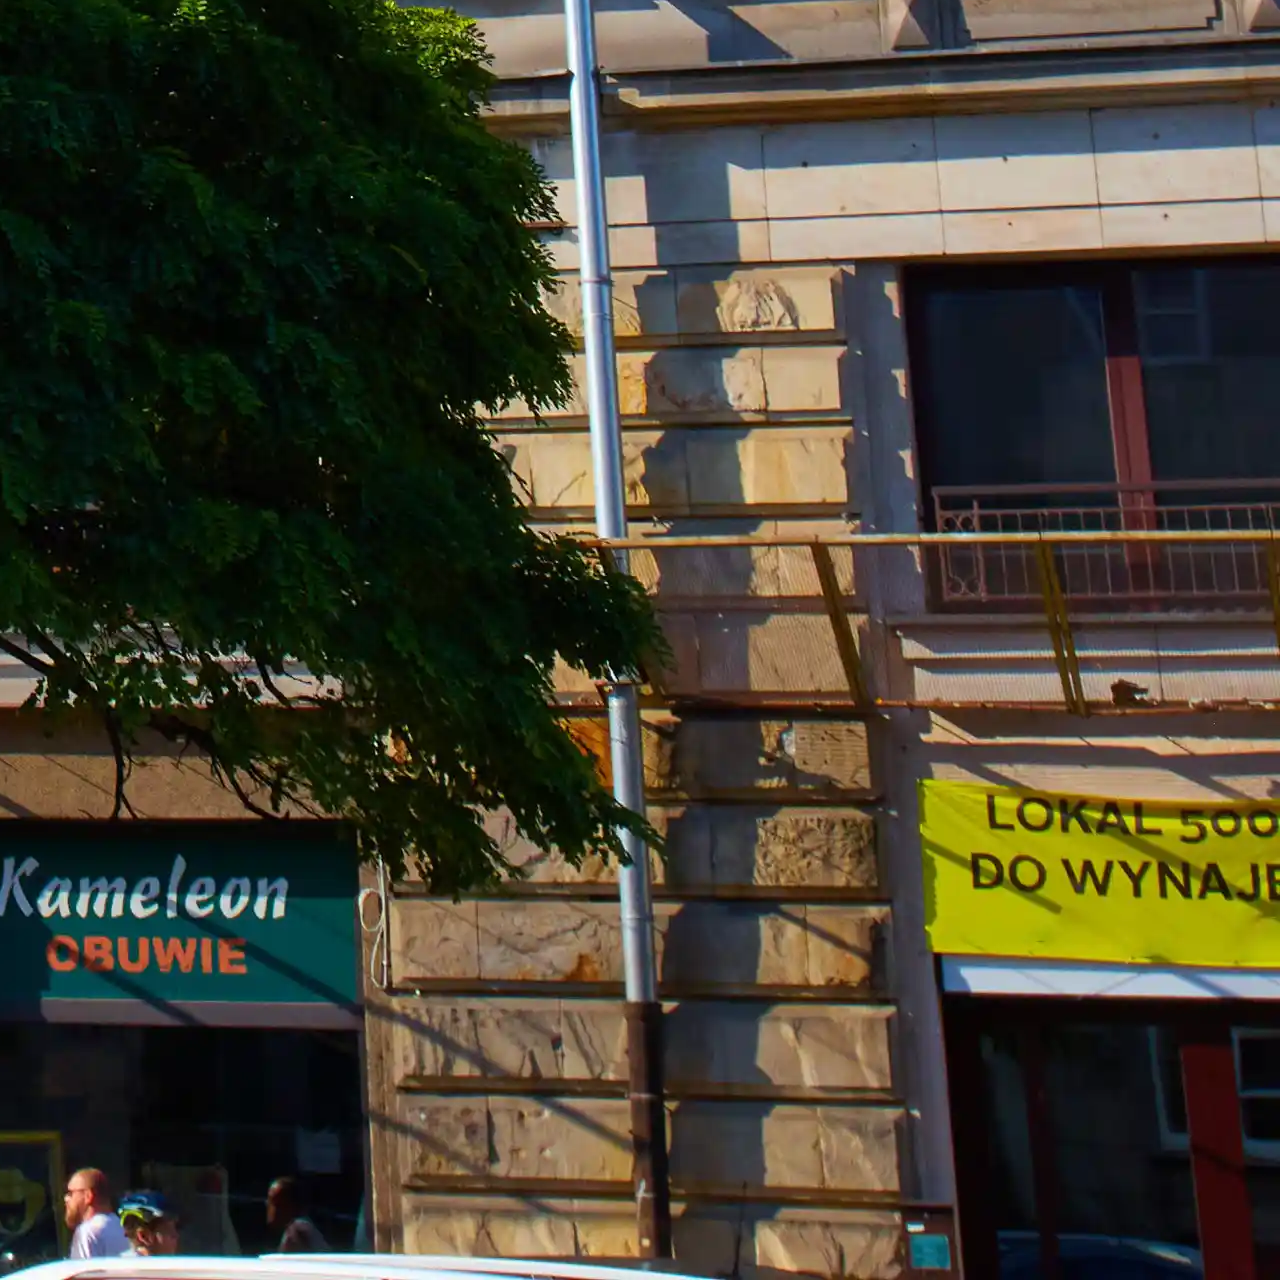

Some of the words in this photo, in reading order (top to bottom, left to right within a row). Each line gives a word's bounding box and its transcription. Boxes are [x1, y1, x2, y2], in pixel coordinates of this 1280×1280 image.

[986, 794, 1163, 836] LOKAL
[1179, 808, 1280, 844] 500
[970, 851, 1047, 892] DO
[45, 934, 248, 975] OBUWIE
